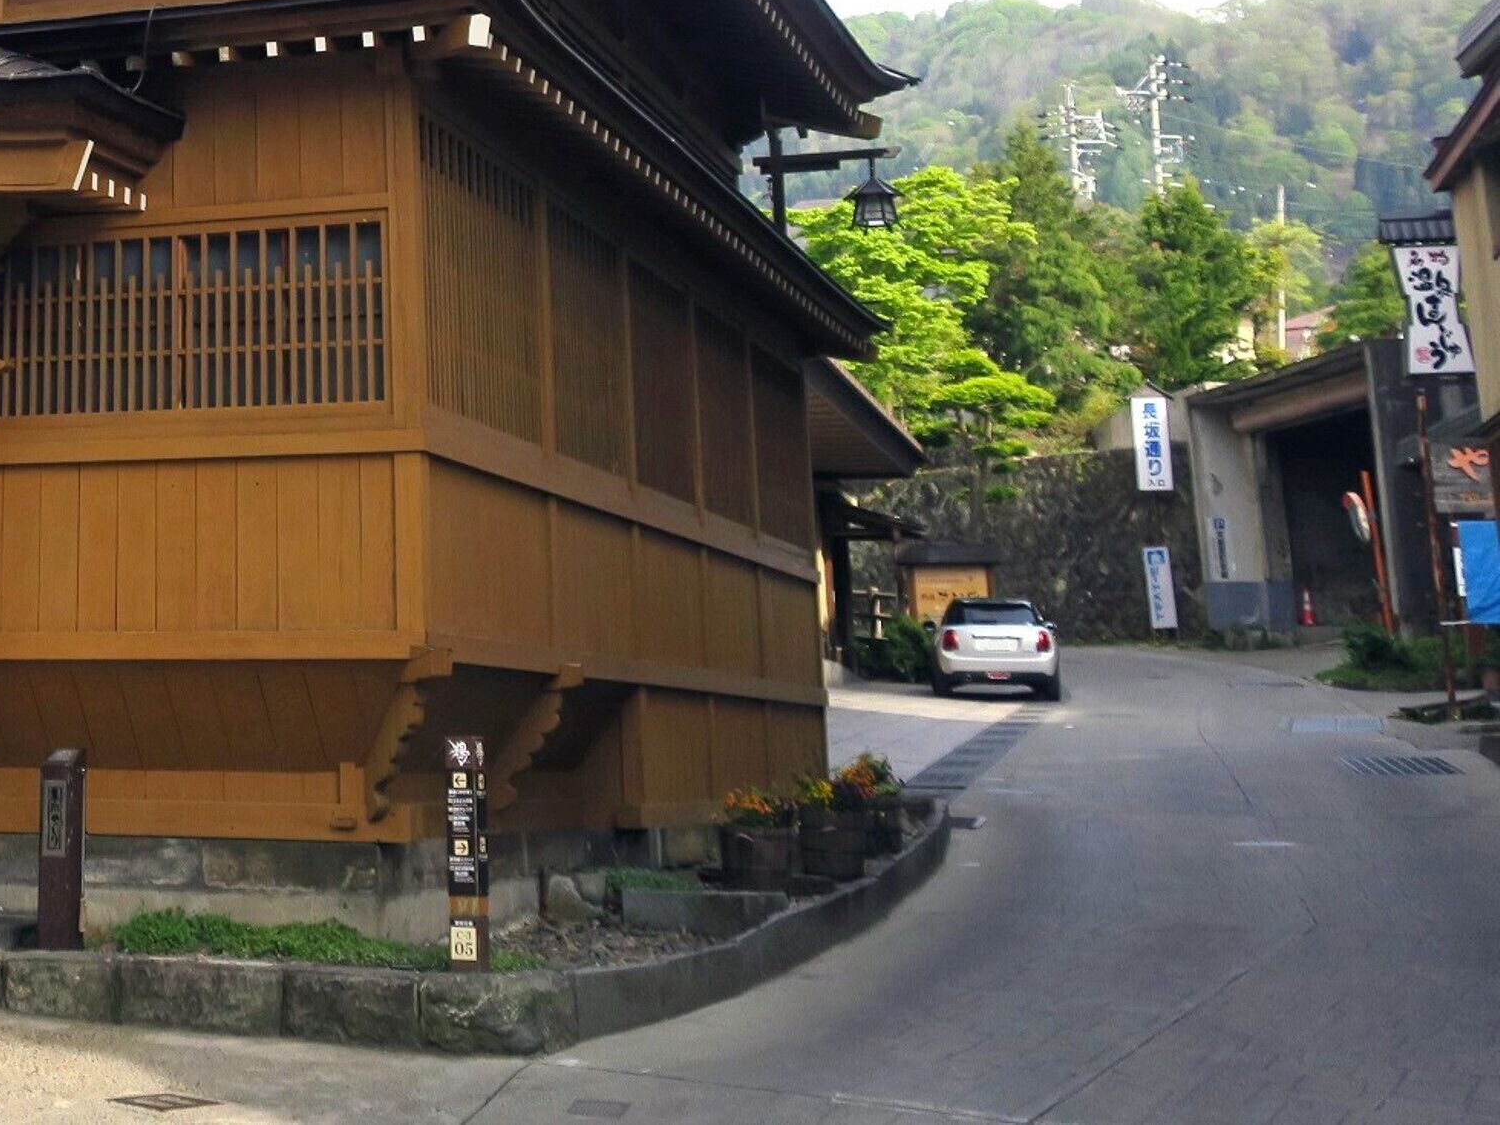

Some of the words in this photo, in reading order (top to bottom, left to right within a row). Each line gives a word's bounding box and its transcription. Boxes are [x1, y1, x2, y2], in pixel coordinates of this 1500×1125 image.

[1143, 402, 1162, 476] 長坂通り
[454, 942, 473, 957] 05
